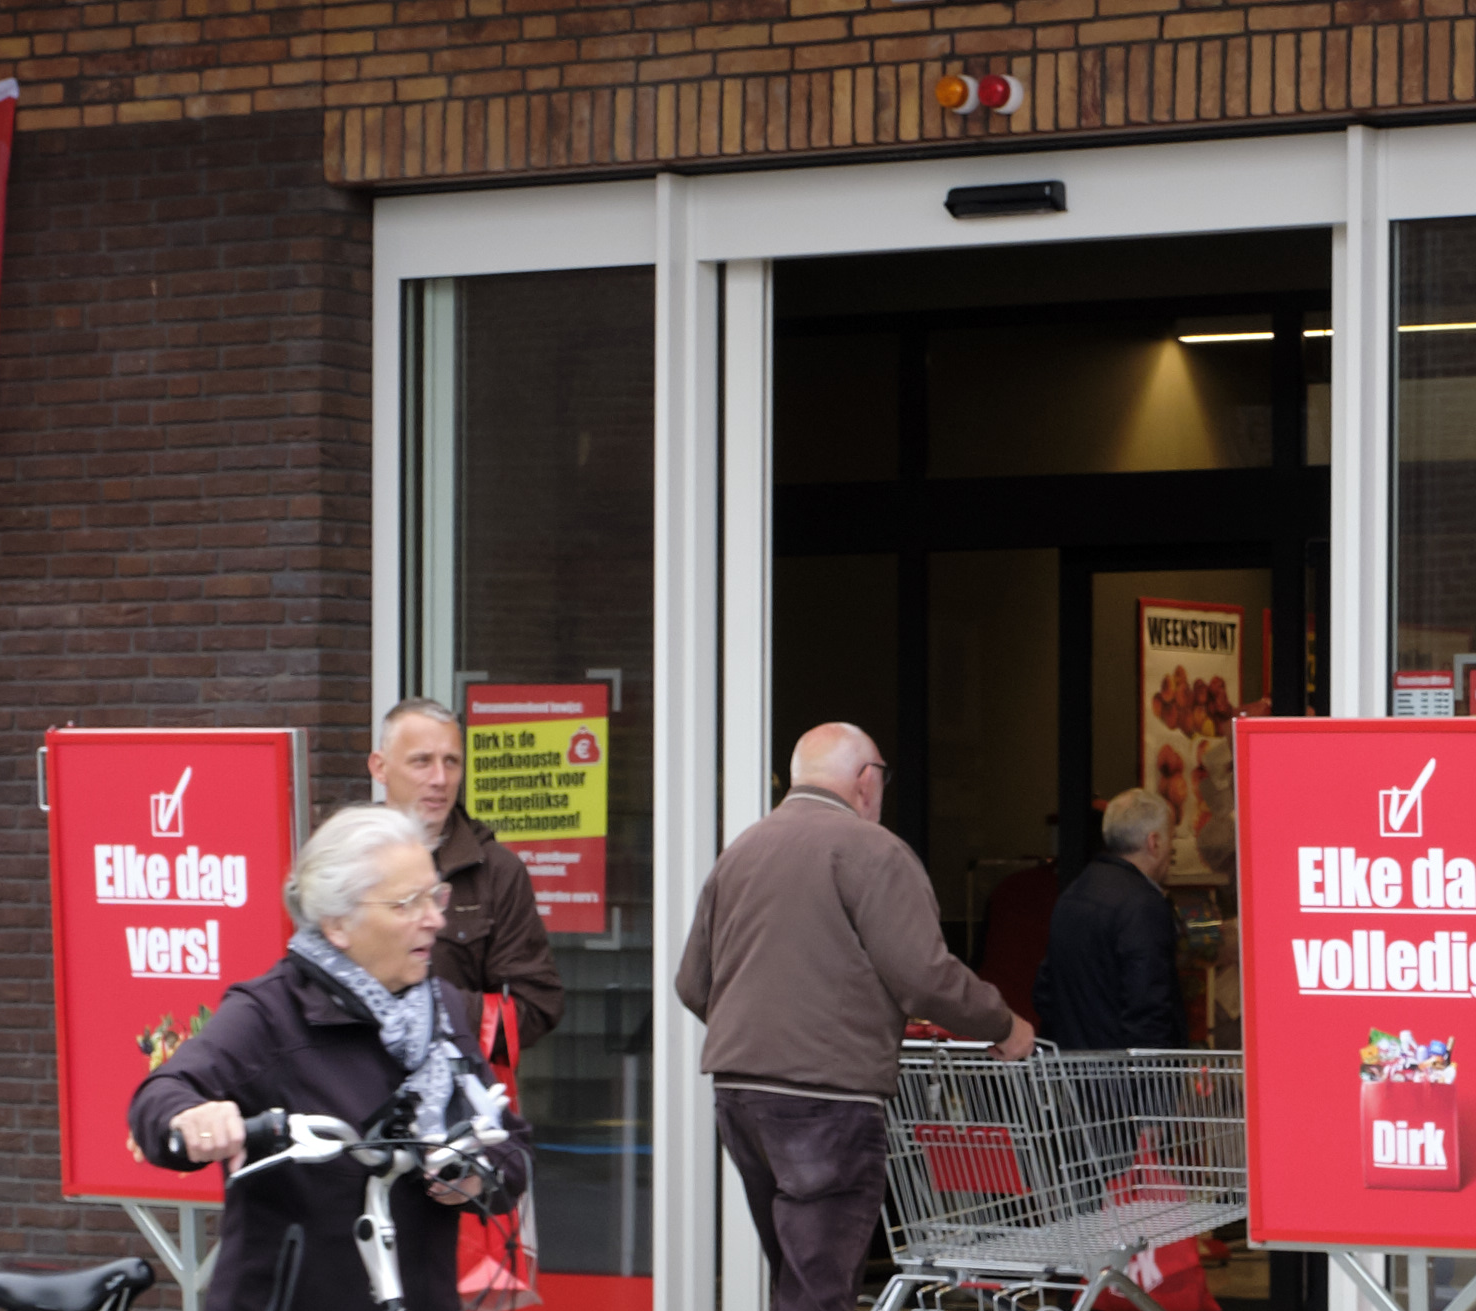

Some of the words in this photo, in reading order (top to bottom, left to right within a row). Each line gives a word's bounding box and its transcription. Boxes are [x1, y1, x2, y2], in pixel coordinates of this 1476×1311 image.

[1147, 616, 1237, 653] WEEKSTUNT
[473, 732, 500, 750] Dirk
[502, 732, 515, 748] is
[518, 731, 535, 748] de
[474, 751, 561, 771] goedkoopste
[474, 772, 552, 792] supermarkt
[556, 771, 587, 787] voor
[475, 798, 494, 813] uw
[497, 793, 569, 810] dagelijkse
[94, 844, 170, 900] Elke
[175, 845, 248, 908] dag
[1298, 846, 1403, 908] Elke
[125, 919, 221, 974] vers!
[1372, 1119, 1448, 1166] Dirk
